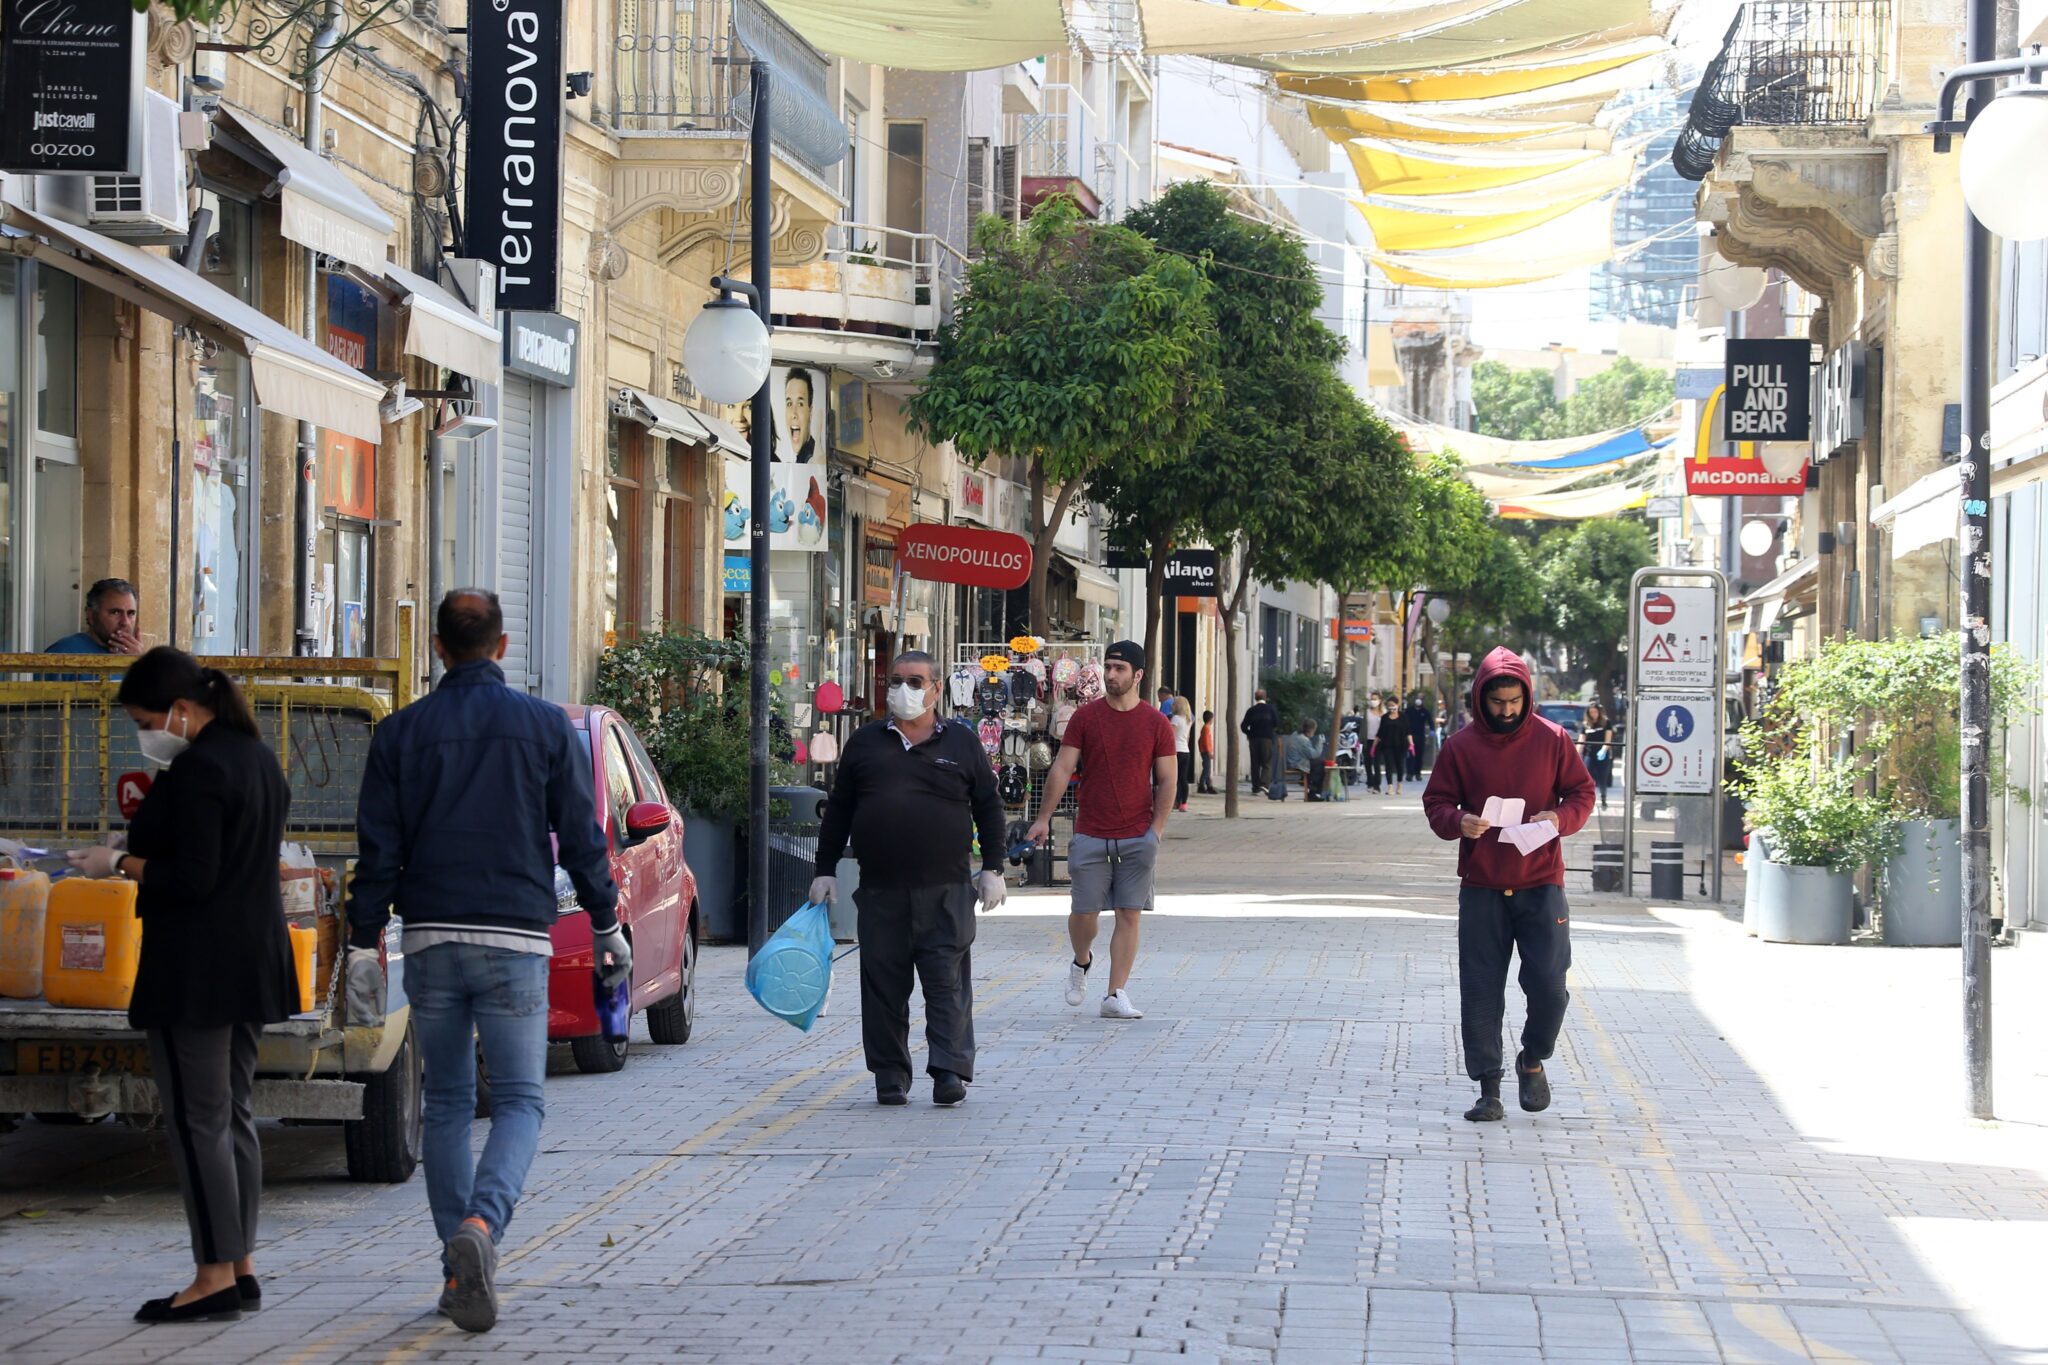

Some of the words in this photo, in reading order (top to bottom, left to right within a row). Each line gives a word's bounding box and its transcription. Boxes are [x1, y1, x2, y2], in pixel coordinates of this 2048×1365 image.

[32, 92, 98, 100] WELLINGTON
[500, 11, 540, 294] Terranova
[1733, 364, 1788, 388] PULL
[1743, 387, 1788, 411] AND
[1731, 410, 1788, 433] BEAR
[1691, 470, 1803, 485] McDonads
[905, 541, 1022, 571] XENOPOULLOS
